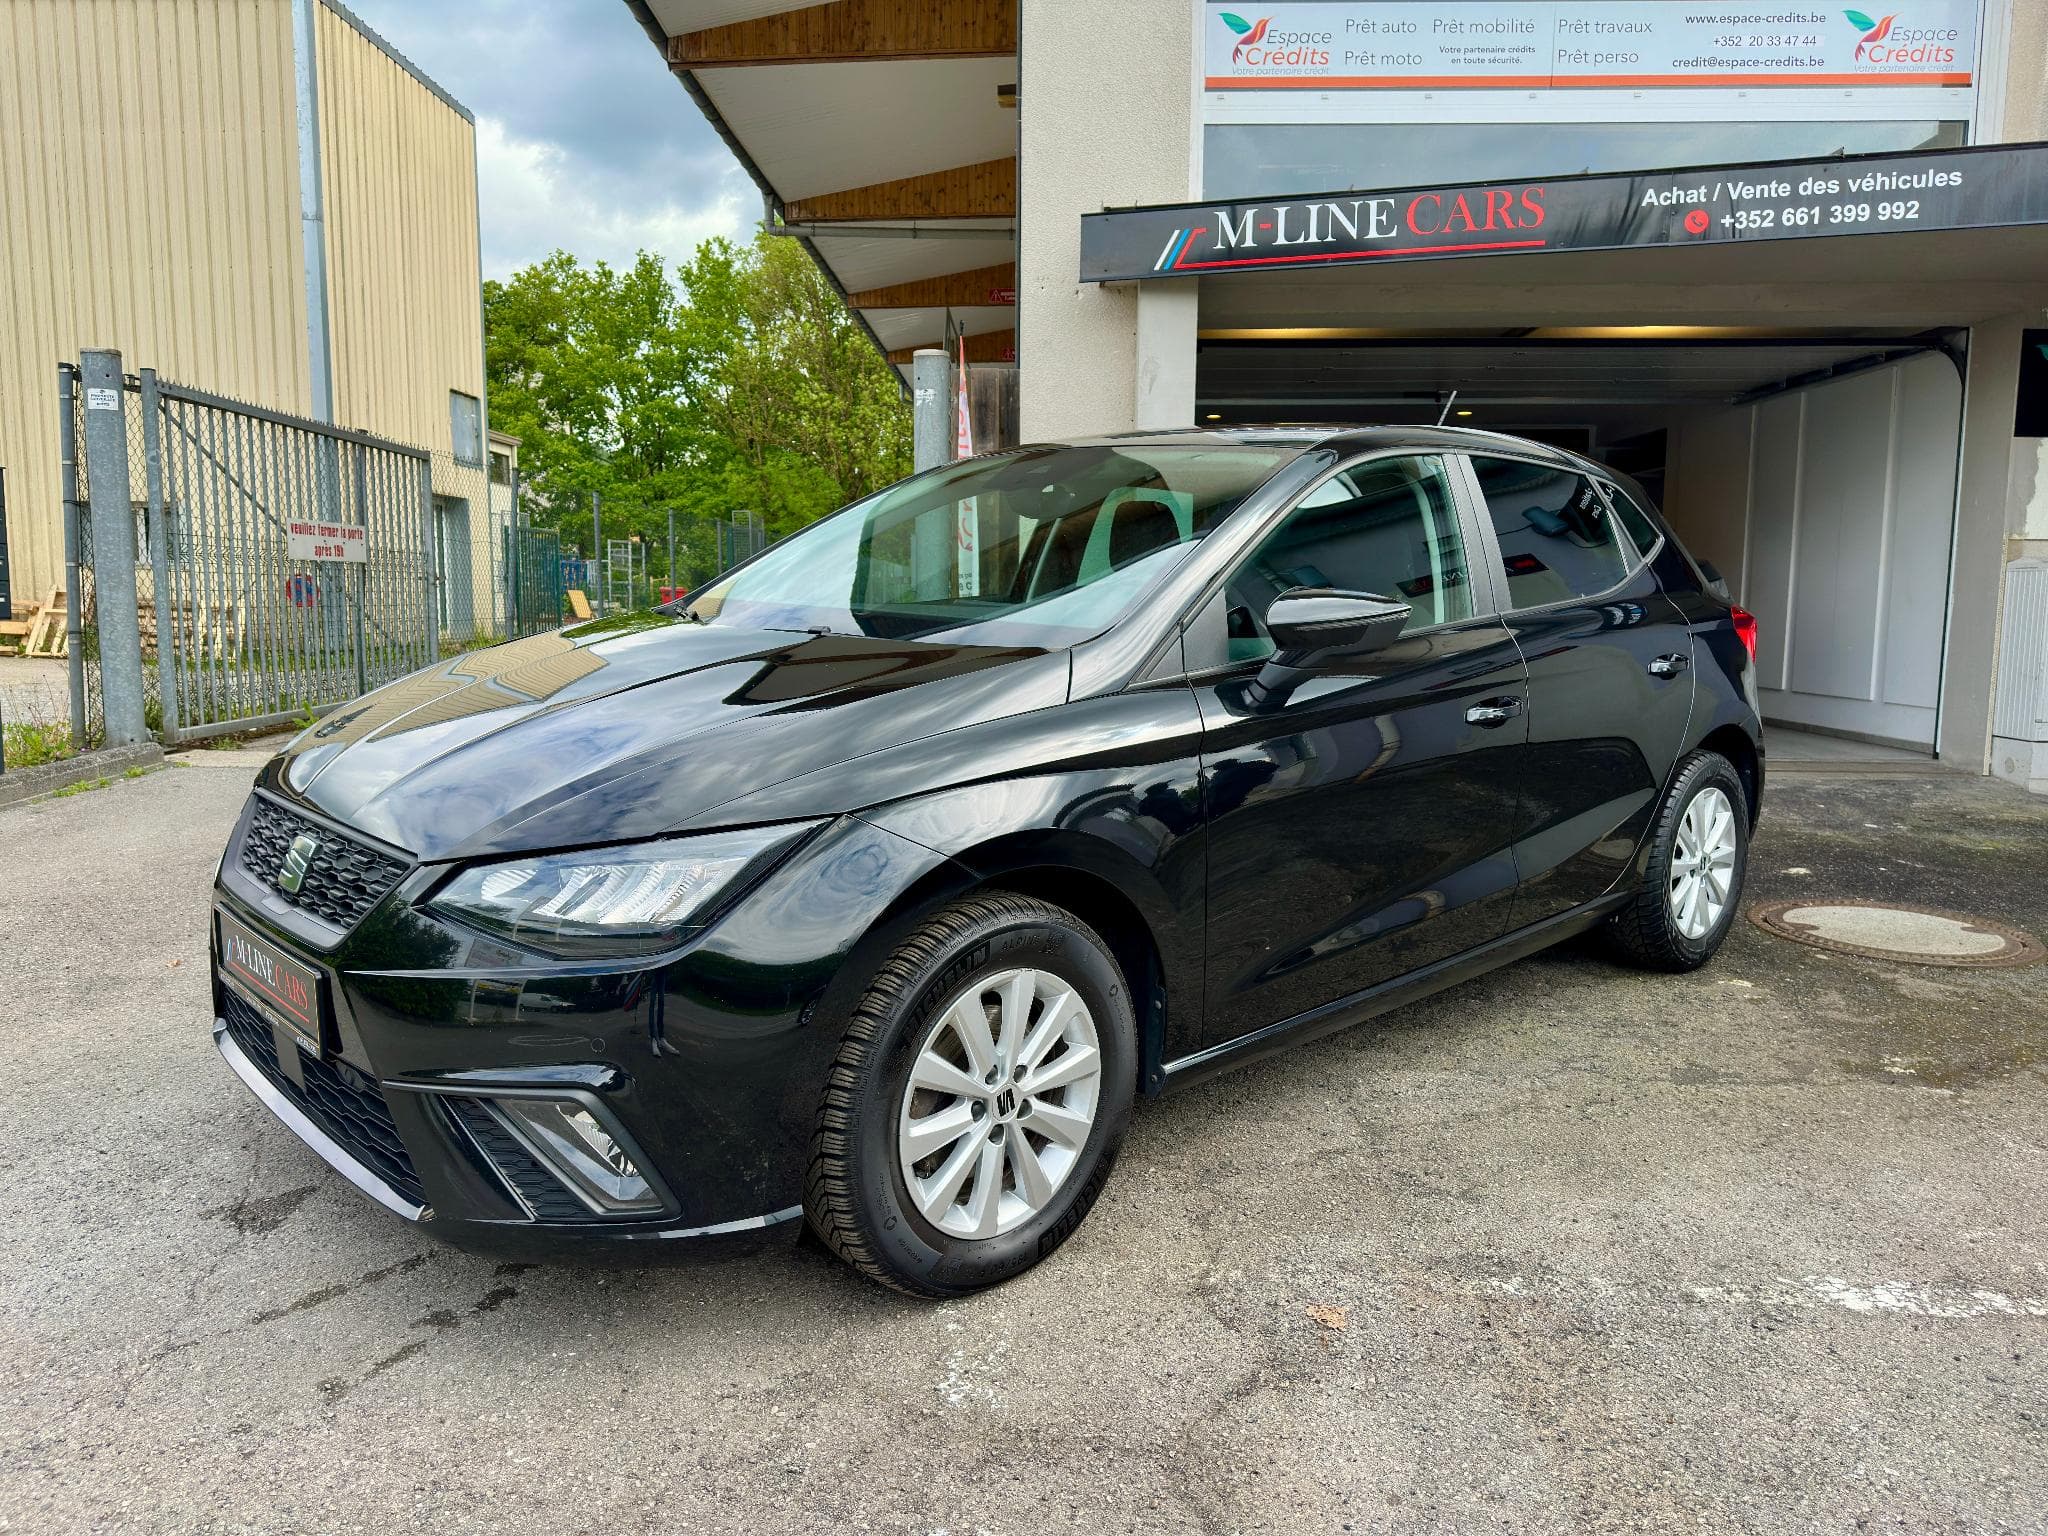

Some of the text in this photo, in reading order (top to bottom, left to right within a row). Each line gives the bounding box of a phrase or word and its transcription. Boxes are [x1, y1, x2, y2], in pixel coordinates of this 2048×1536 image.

[1345, 18, 1417, 33] Prêt auto
[1433, 18, 1535, 33] Prêt mobilité
[1558, 18, 1653, 33] Prêt travaux
[1685, 12, 1827, 26] www.espace-credits.be
[1266, 29, 1332, 47] Espace
[1713, 35, 1817, 47] +352 20 33 47 44
[1890, 26, 1958, 45] Espace
[1246, 46, 1330, 65] Crédits
[1344, 50, 1423, 65] Prêt moto
[1463, 45, 1506, 55] partenaire
[1508, 45, 1536, 53] crédits
[1869, 43, 1955, 63] Crédits
[1487, 56, 1522, 64] sécurité.
[1558, 49, 1639, 67] Prêt perso
[1672, 56, 1825, 69] credit@espace-credits.be
[1256, 66, 1303, 76] partenaire
[1878, 64, 1926, 73] partenaire
[1641, 168, 1963, 207] Achat / Vente des véhicules
[1213, 186, 1546, 250] M-LINE CARS
[1720, 201, 1920, 230] +352 661 399 992
[317, 523, 339, 538] fermer
[340, 526, 346, 539] la
[347, 527, 363, 541] porte
[275, 964, 308, 1010] CARS
